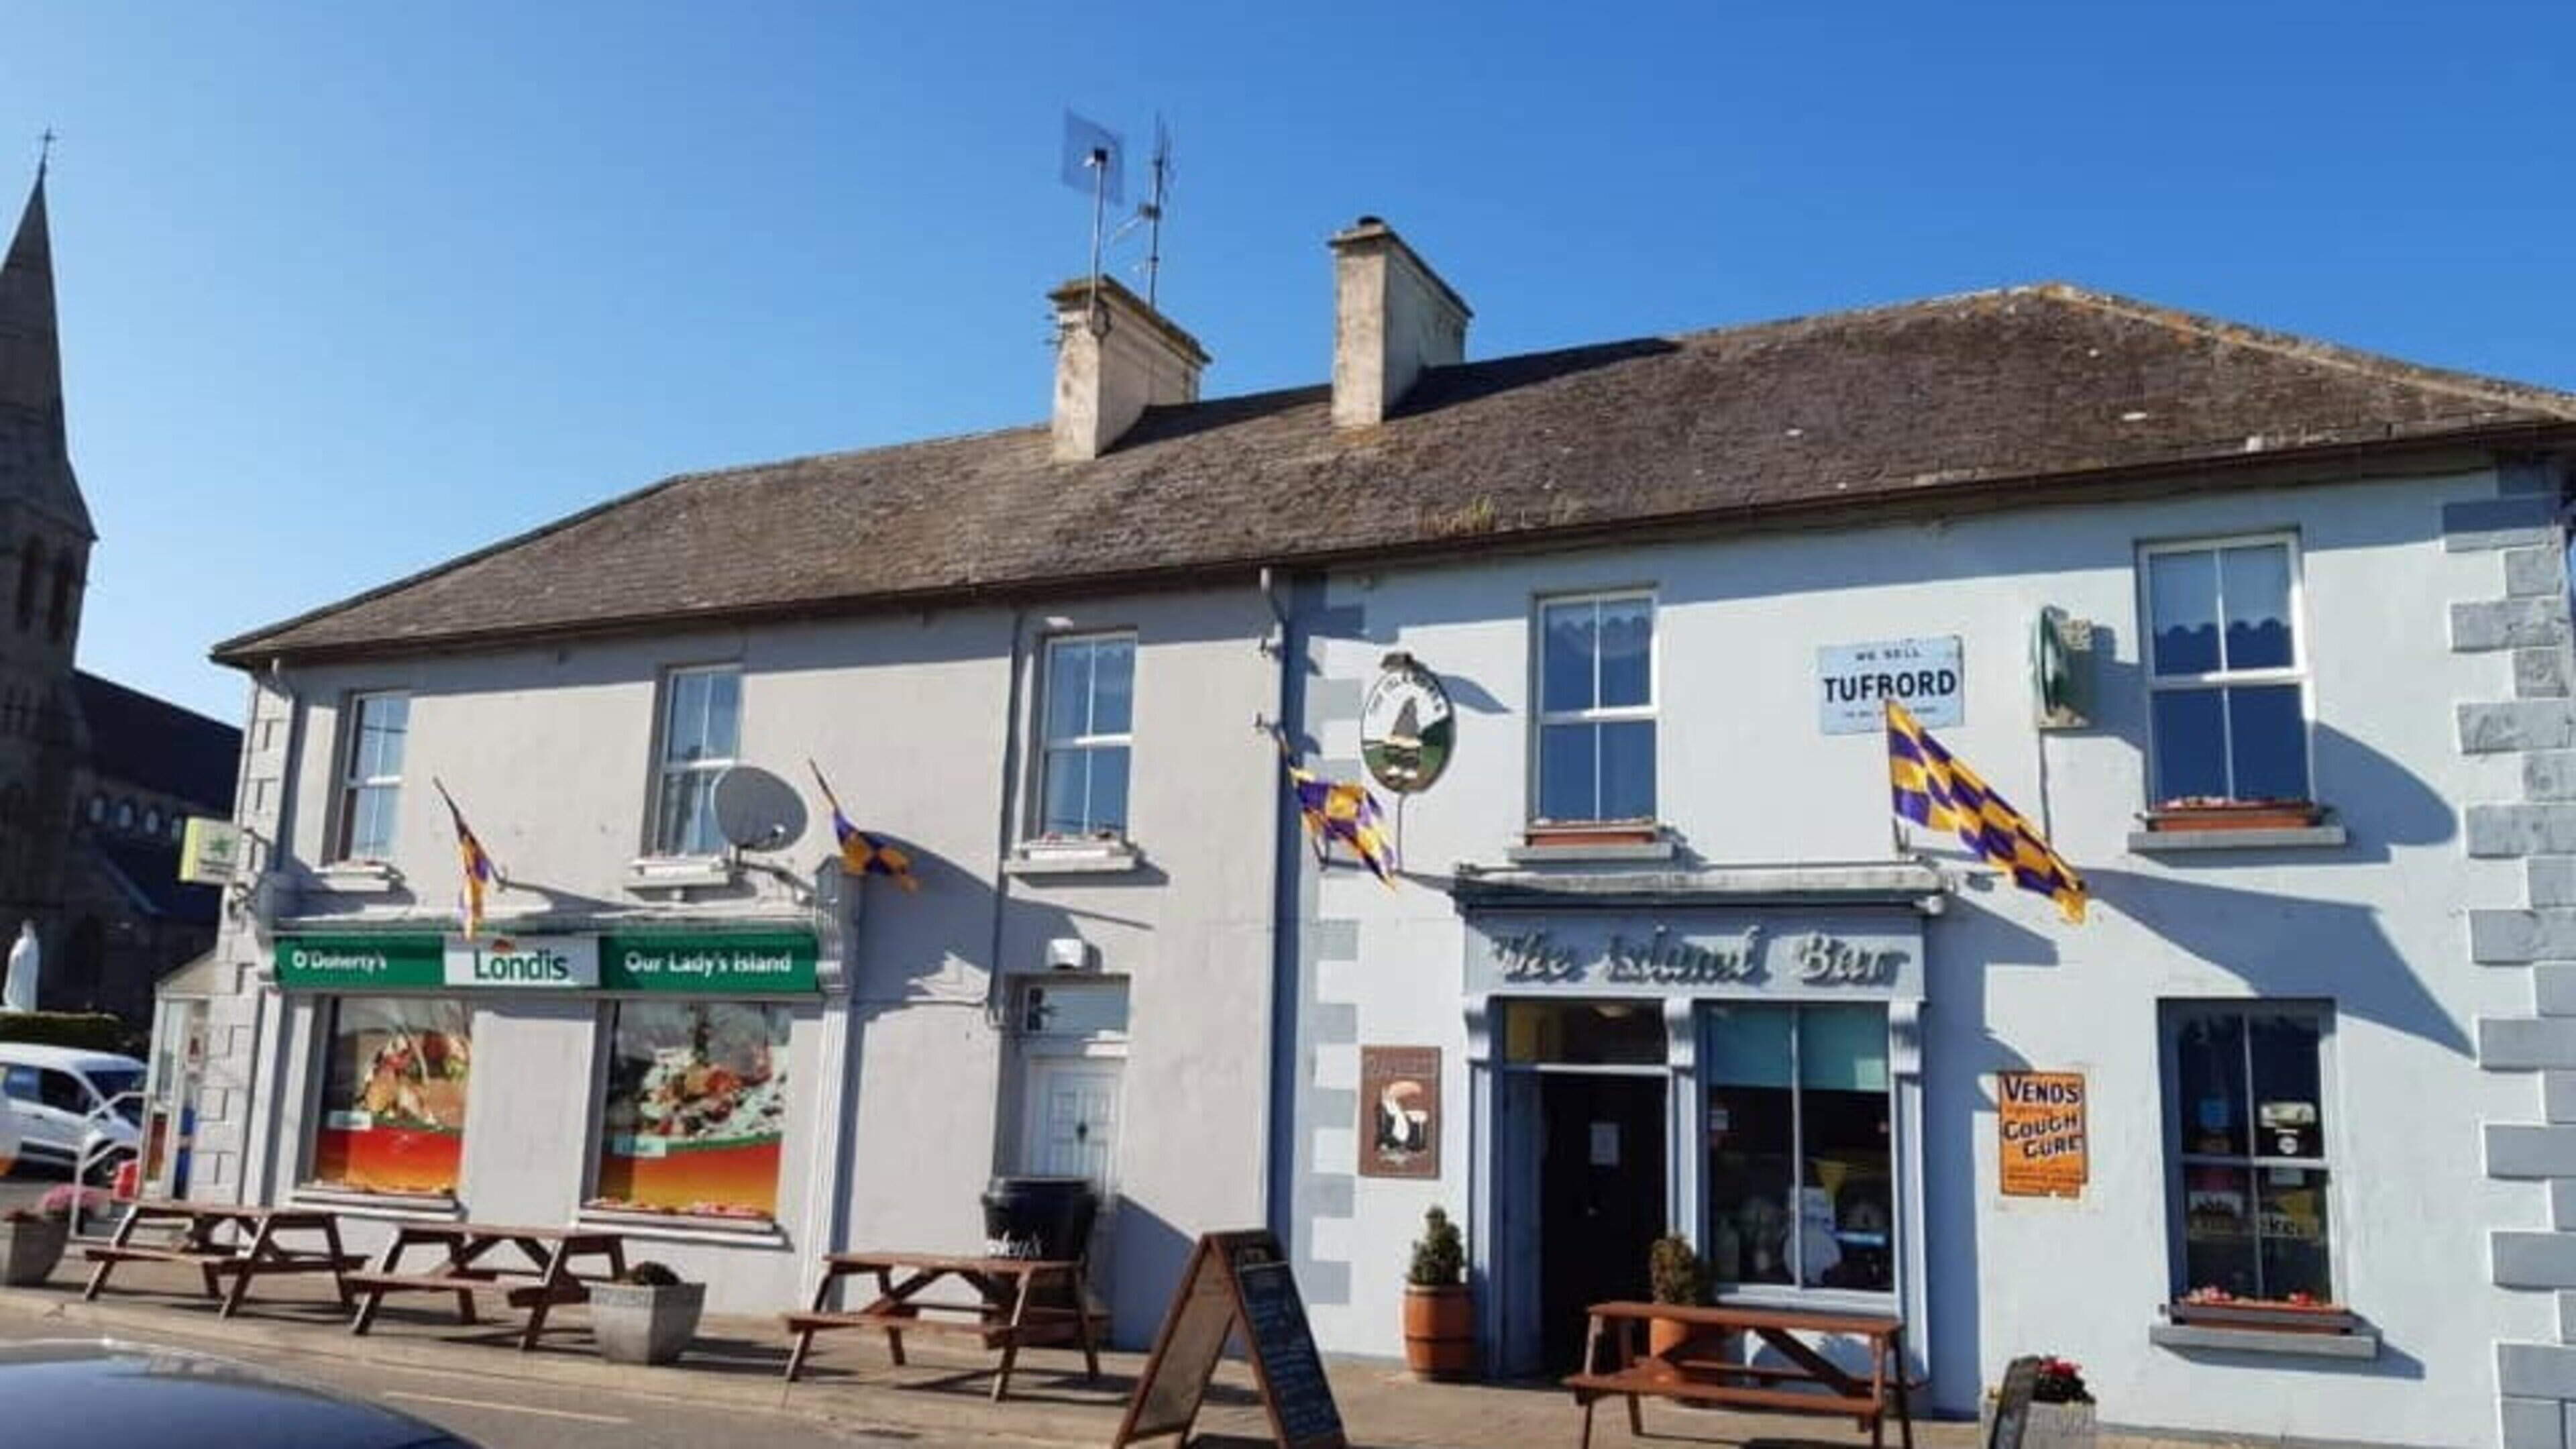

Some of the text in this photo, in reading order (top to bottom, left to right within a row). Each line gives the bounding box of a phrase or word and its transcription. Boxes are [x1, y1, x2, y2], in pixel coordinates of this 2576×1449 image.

[1884, 648, 1919, 659] SELL
[474, 948, 569, 979] Londis
[625, 950, 792, 977] Our Lady's Island
[1799, 930, 1894, 978] Bar
[2004, 1114, 2078, 1140] COUGH
[2023, 1135, 2082, 1158] CURE
